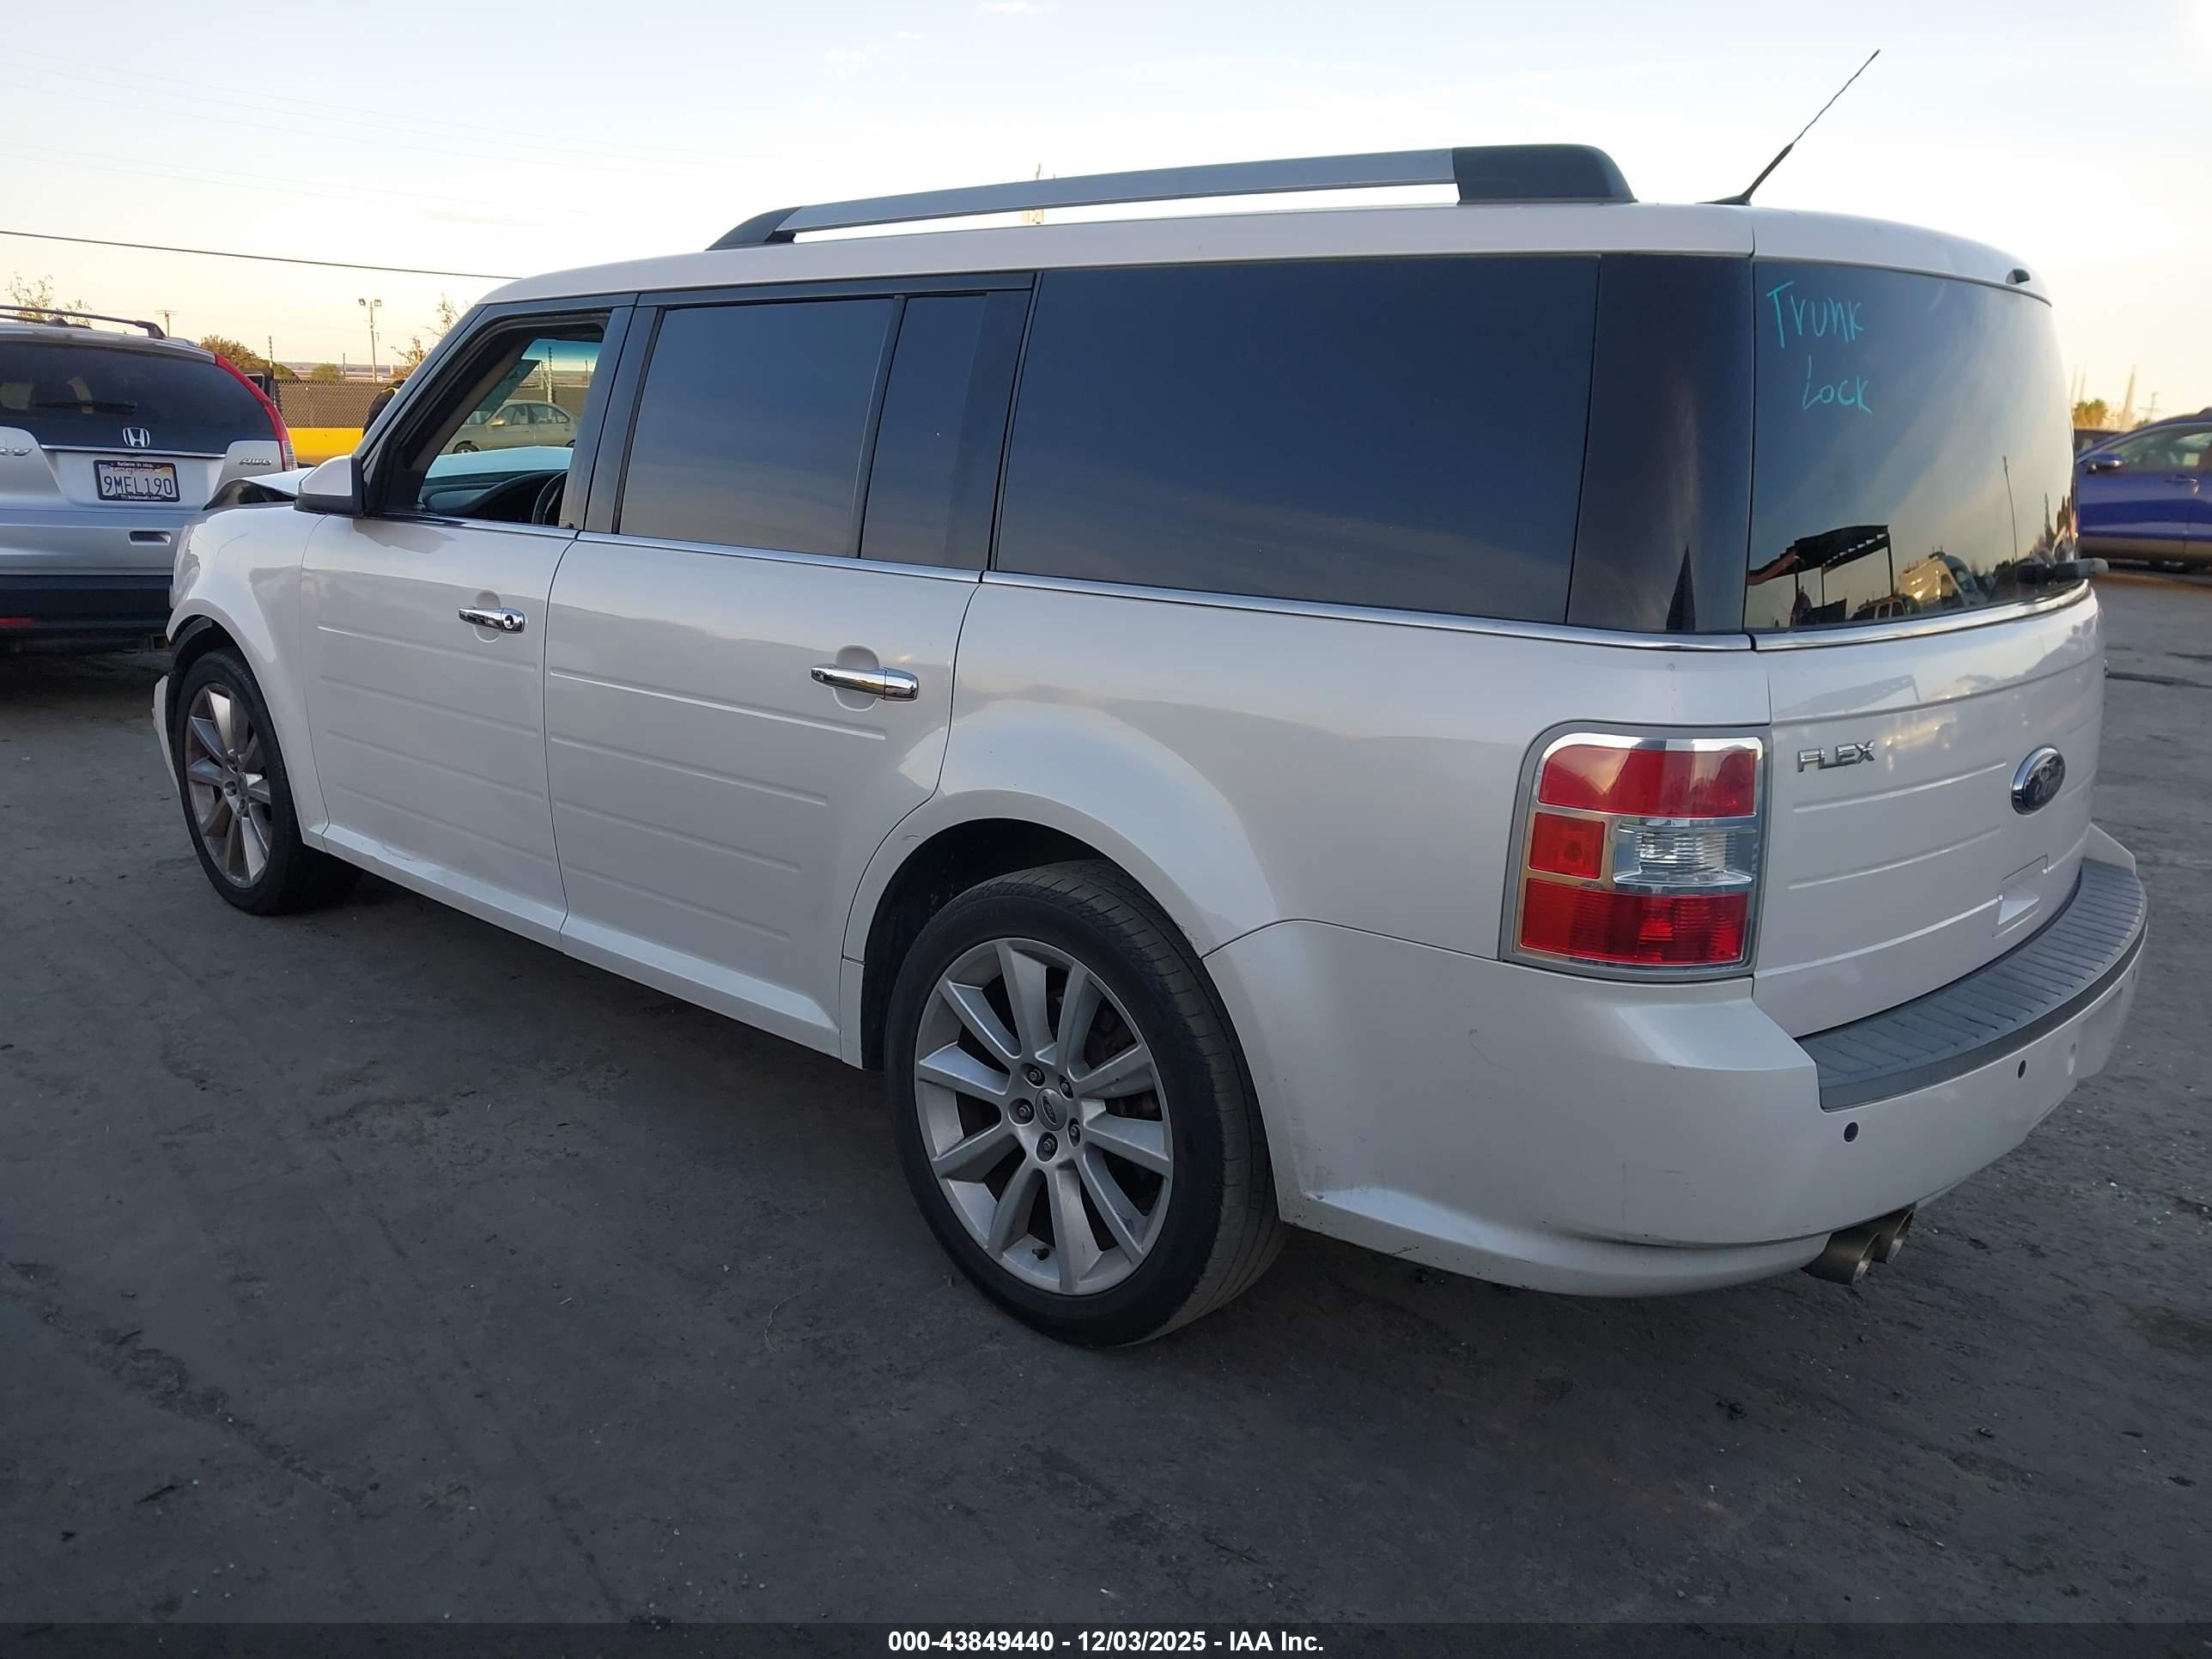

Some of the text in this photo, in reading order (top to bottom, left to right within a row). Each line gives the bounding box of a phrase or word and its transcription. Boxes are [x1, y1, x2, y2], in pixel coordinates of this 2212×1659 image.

[239, 458, 272, 466] AWD
[103, 475, 173, 496] 9MEL190
[1796, 739, 1875, 773] FLEX
